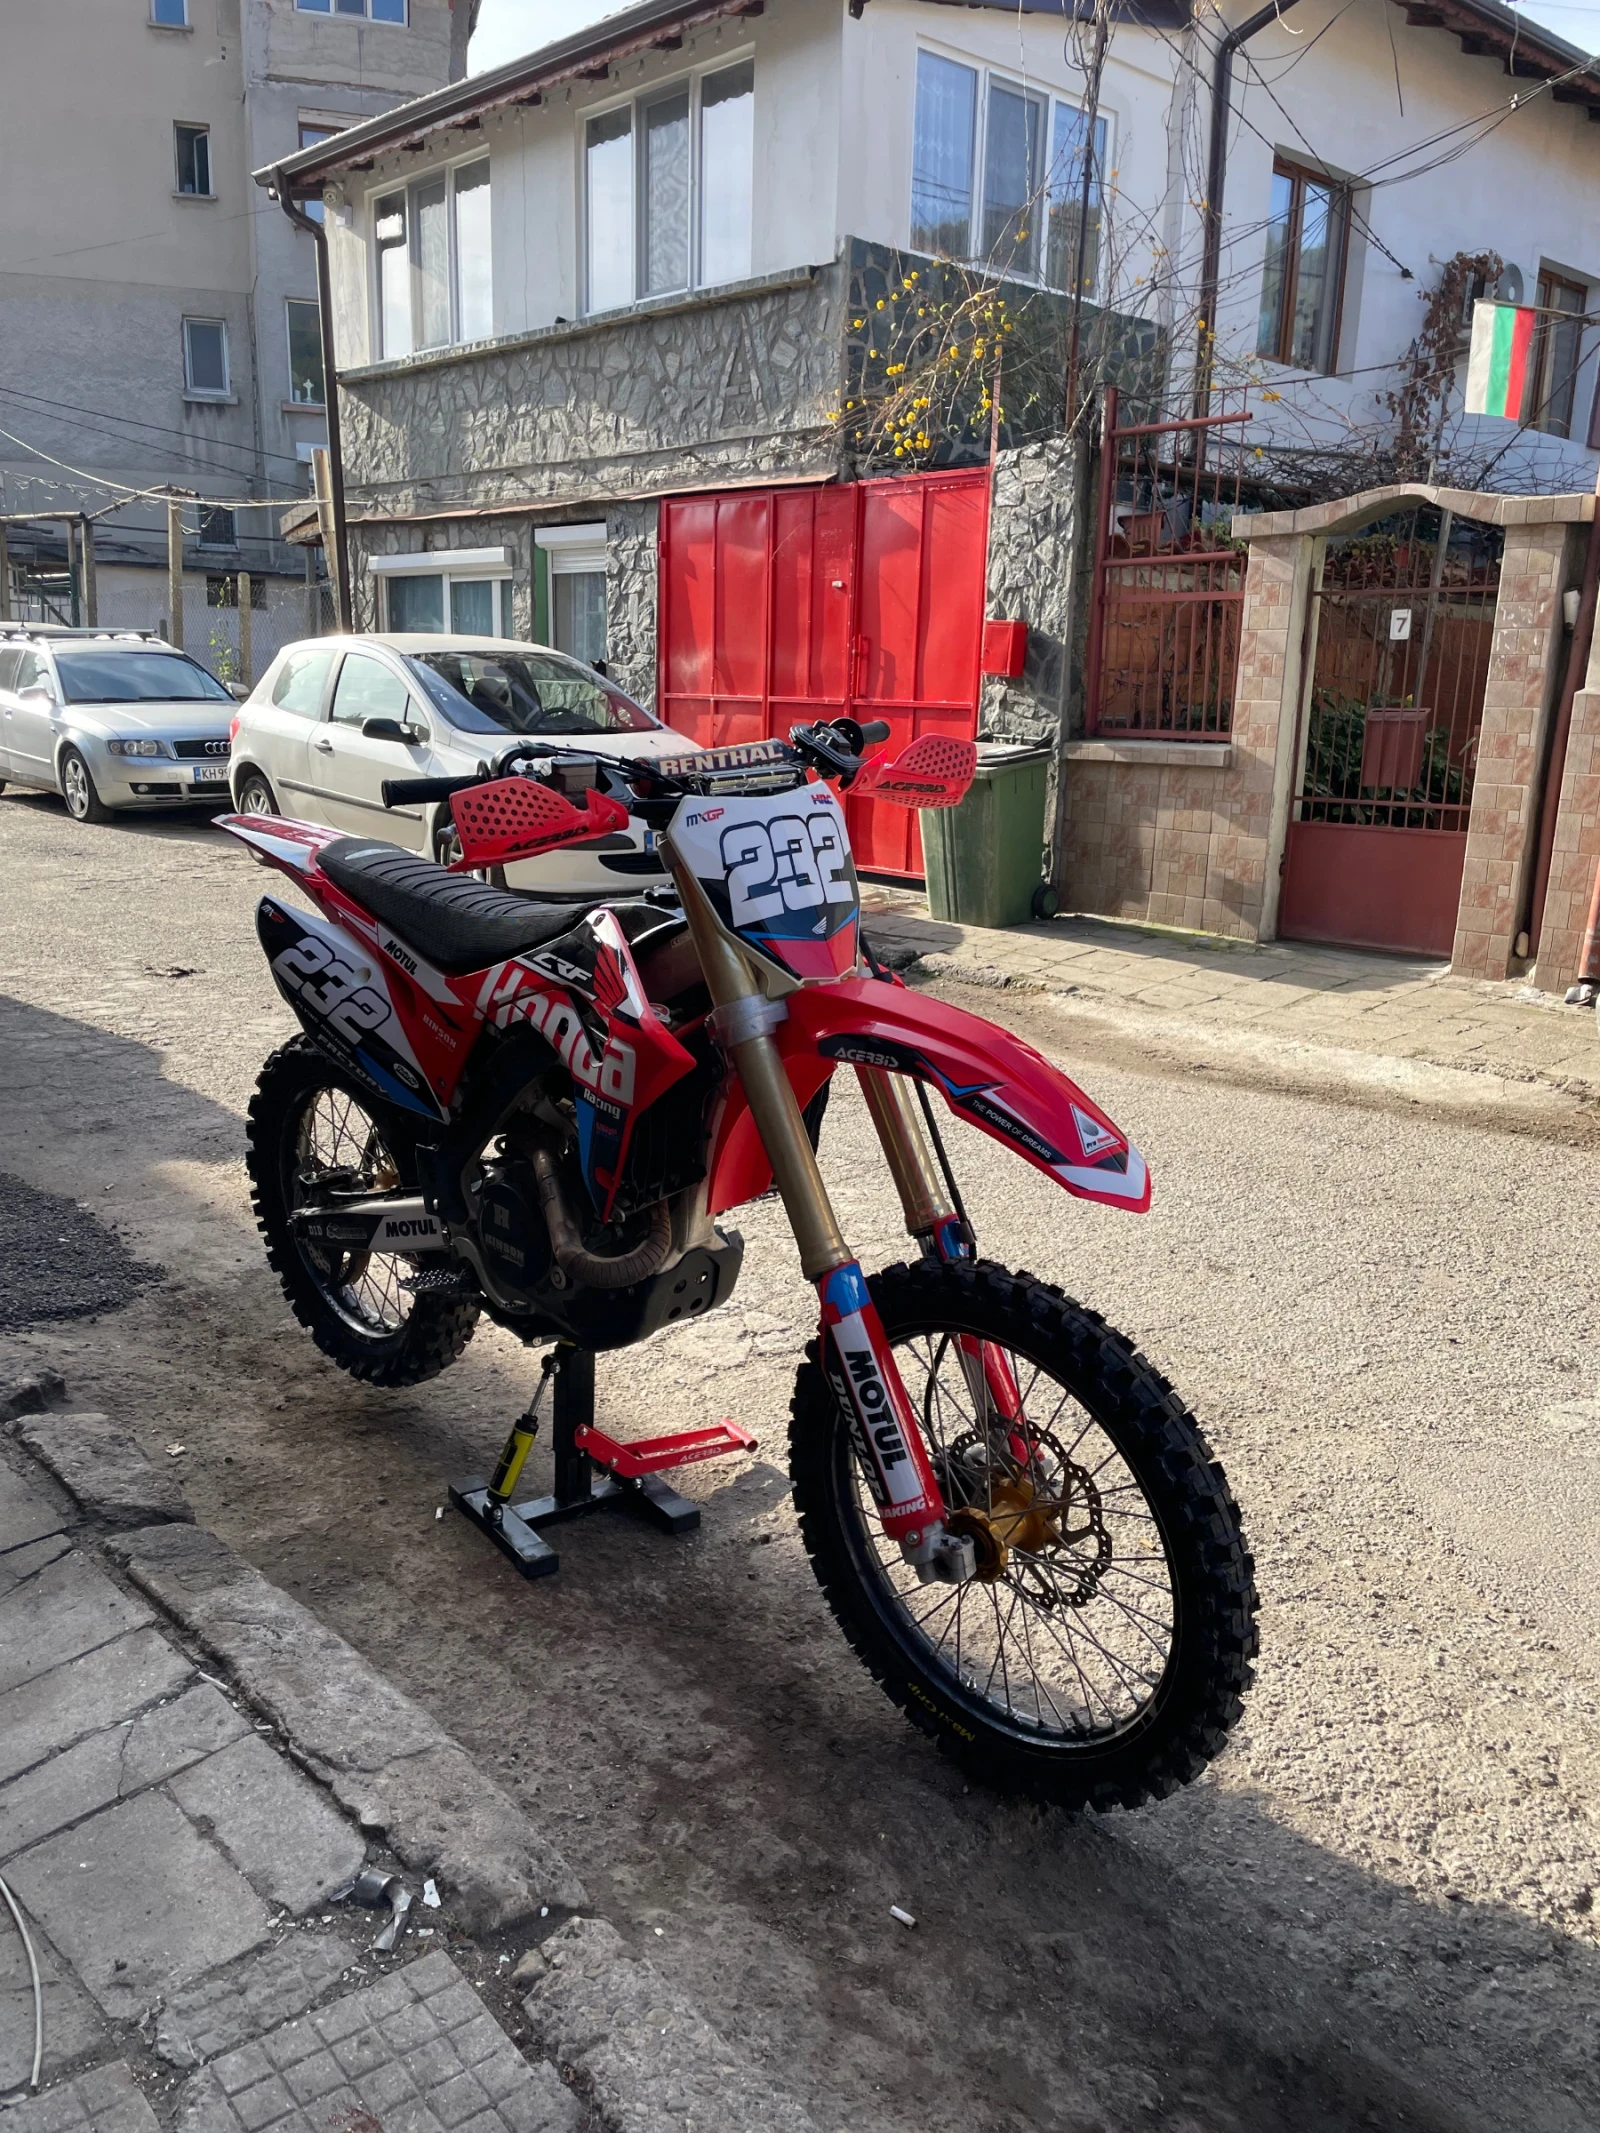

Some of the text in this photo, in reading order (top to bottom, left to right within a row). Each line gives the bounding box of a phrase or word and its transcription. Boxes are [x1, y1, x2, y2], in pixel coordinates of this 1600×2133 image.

[1396, 617, 1407, 633] 7
[659, 744, 784, 776] RENTHAL
[719, 812, 854, 928] 232
[384, 939, 418, 976] MOTUL
[533, 952, 593, 981] CRF
[271, 934, 392, 1045] 232
[317, 1033, 388, 1094] FACTORY
[834, 1046, 899, 1068] ACERBIS
[583, 1088, 621, 1119] Racing
[972, 1099, 1052, 1159] THE POWER OF DREAMS
[386, 1219, 437, 1238] MOTUL
[845, 1350, 908, 1471] MOTUL
[829, 1371, 885, 1501] DUNLOP
